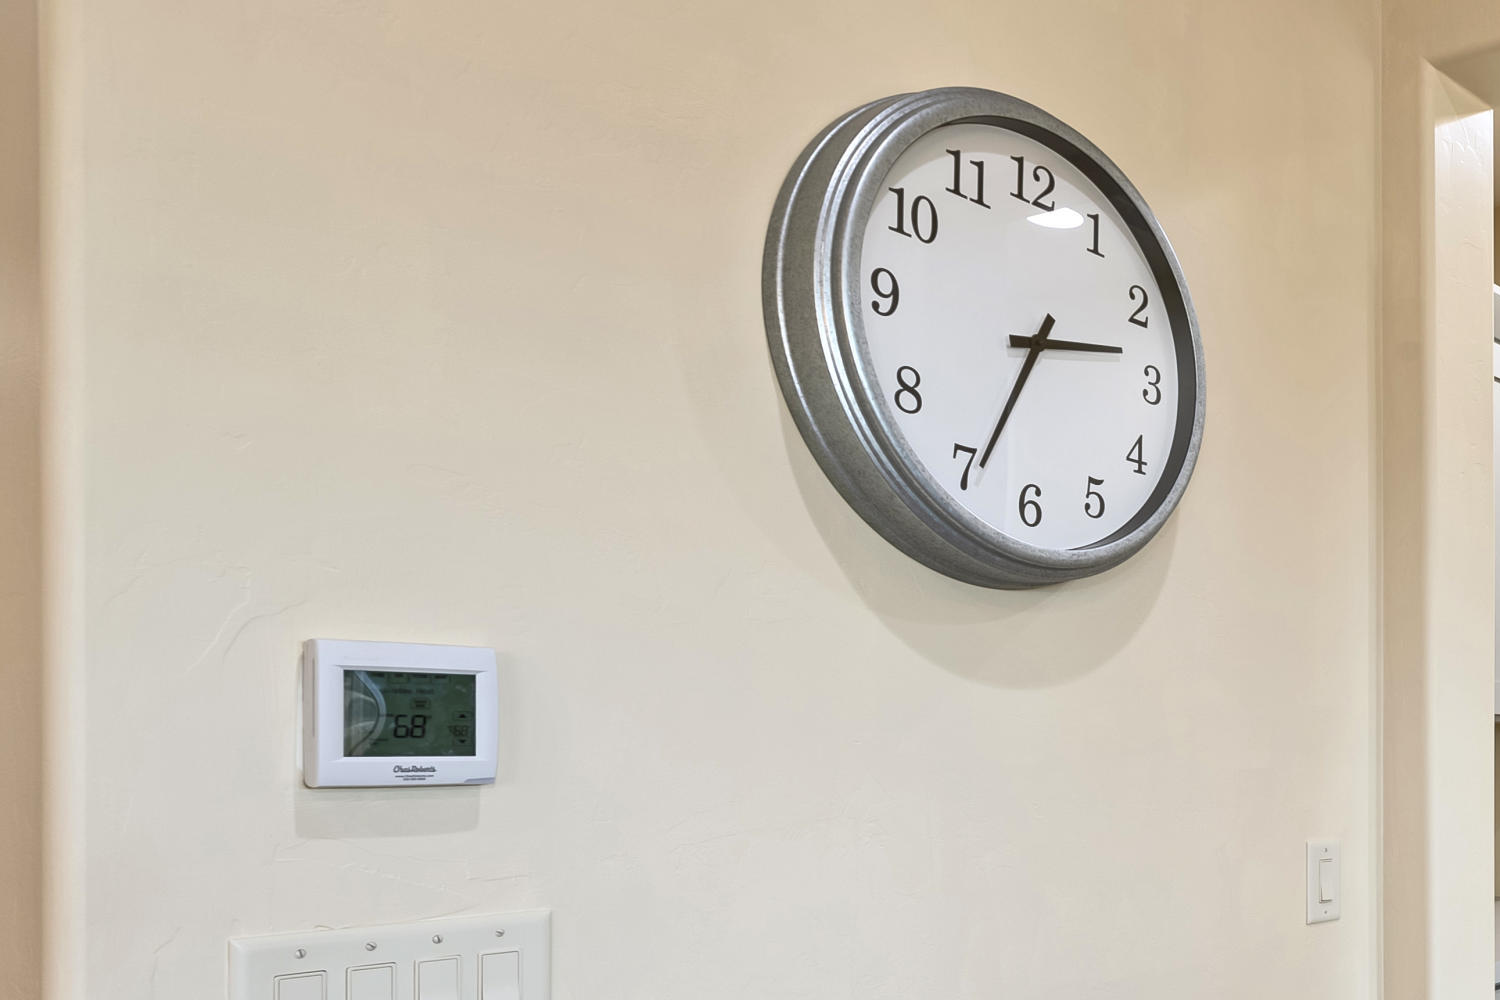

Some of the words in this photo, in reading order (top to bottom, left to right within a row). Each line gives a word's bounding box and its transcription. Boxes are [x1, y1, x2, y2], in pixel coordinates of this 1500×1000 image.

[945, 148, 991, 210] 11
[1009, 155, 1056, 212] 12
[888, 186, 939, 244] 10
[1086, 213, 1105, 259] 1
[870, 267, 900, 317] 9
[1127, 284, 1149, 329] 2
[894, 365, 923, 415] 8
[1142, 364, 1162, 406] 3
[952, 442, 978, 491] 7
[1126, 434, 1148, 476] 4
[1018, 483, 1042, 528] 6
[1084, 476, 1106, 519] 5
[393, 714, 427, 739] 68
